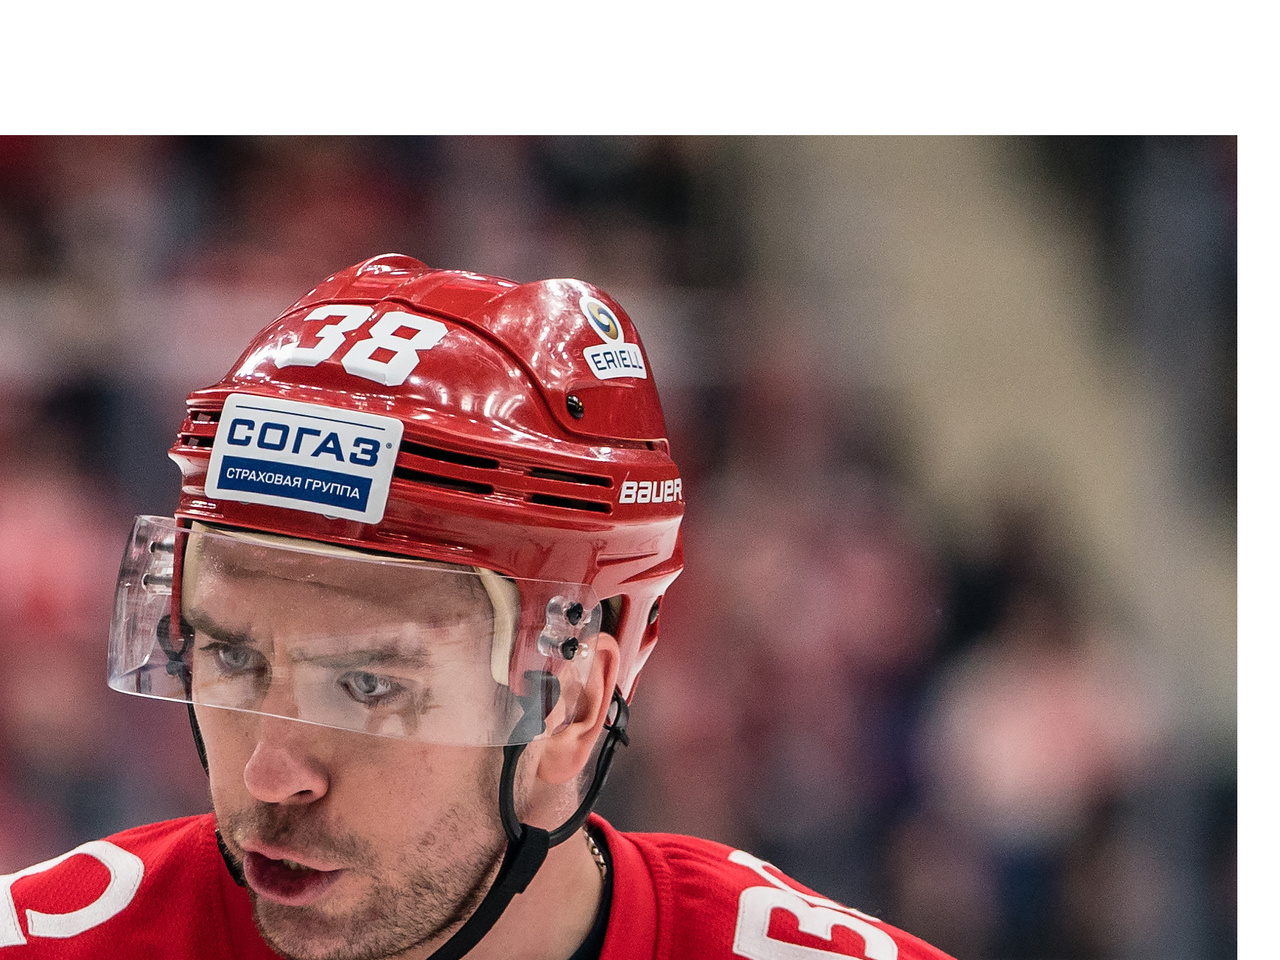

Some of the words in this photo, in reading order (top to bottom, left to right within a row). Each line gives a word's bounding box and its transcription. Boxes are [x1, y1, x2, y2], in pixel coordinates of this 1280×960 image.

[274, 304, 449, 387] 38
[591, 350, 643, 371] ERIELL
[226, 467, 304, 488] СТРАХОВАЯ
[304, 478, 361, 500] ГРУППА
